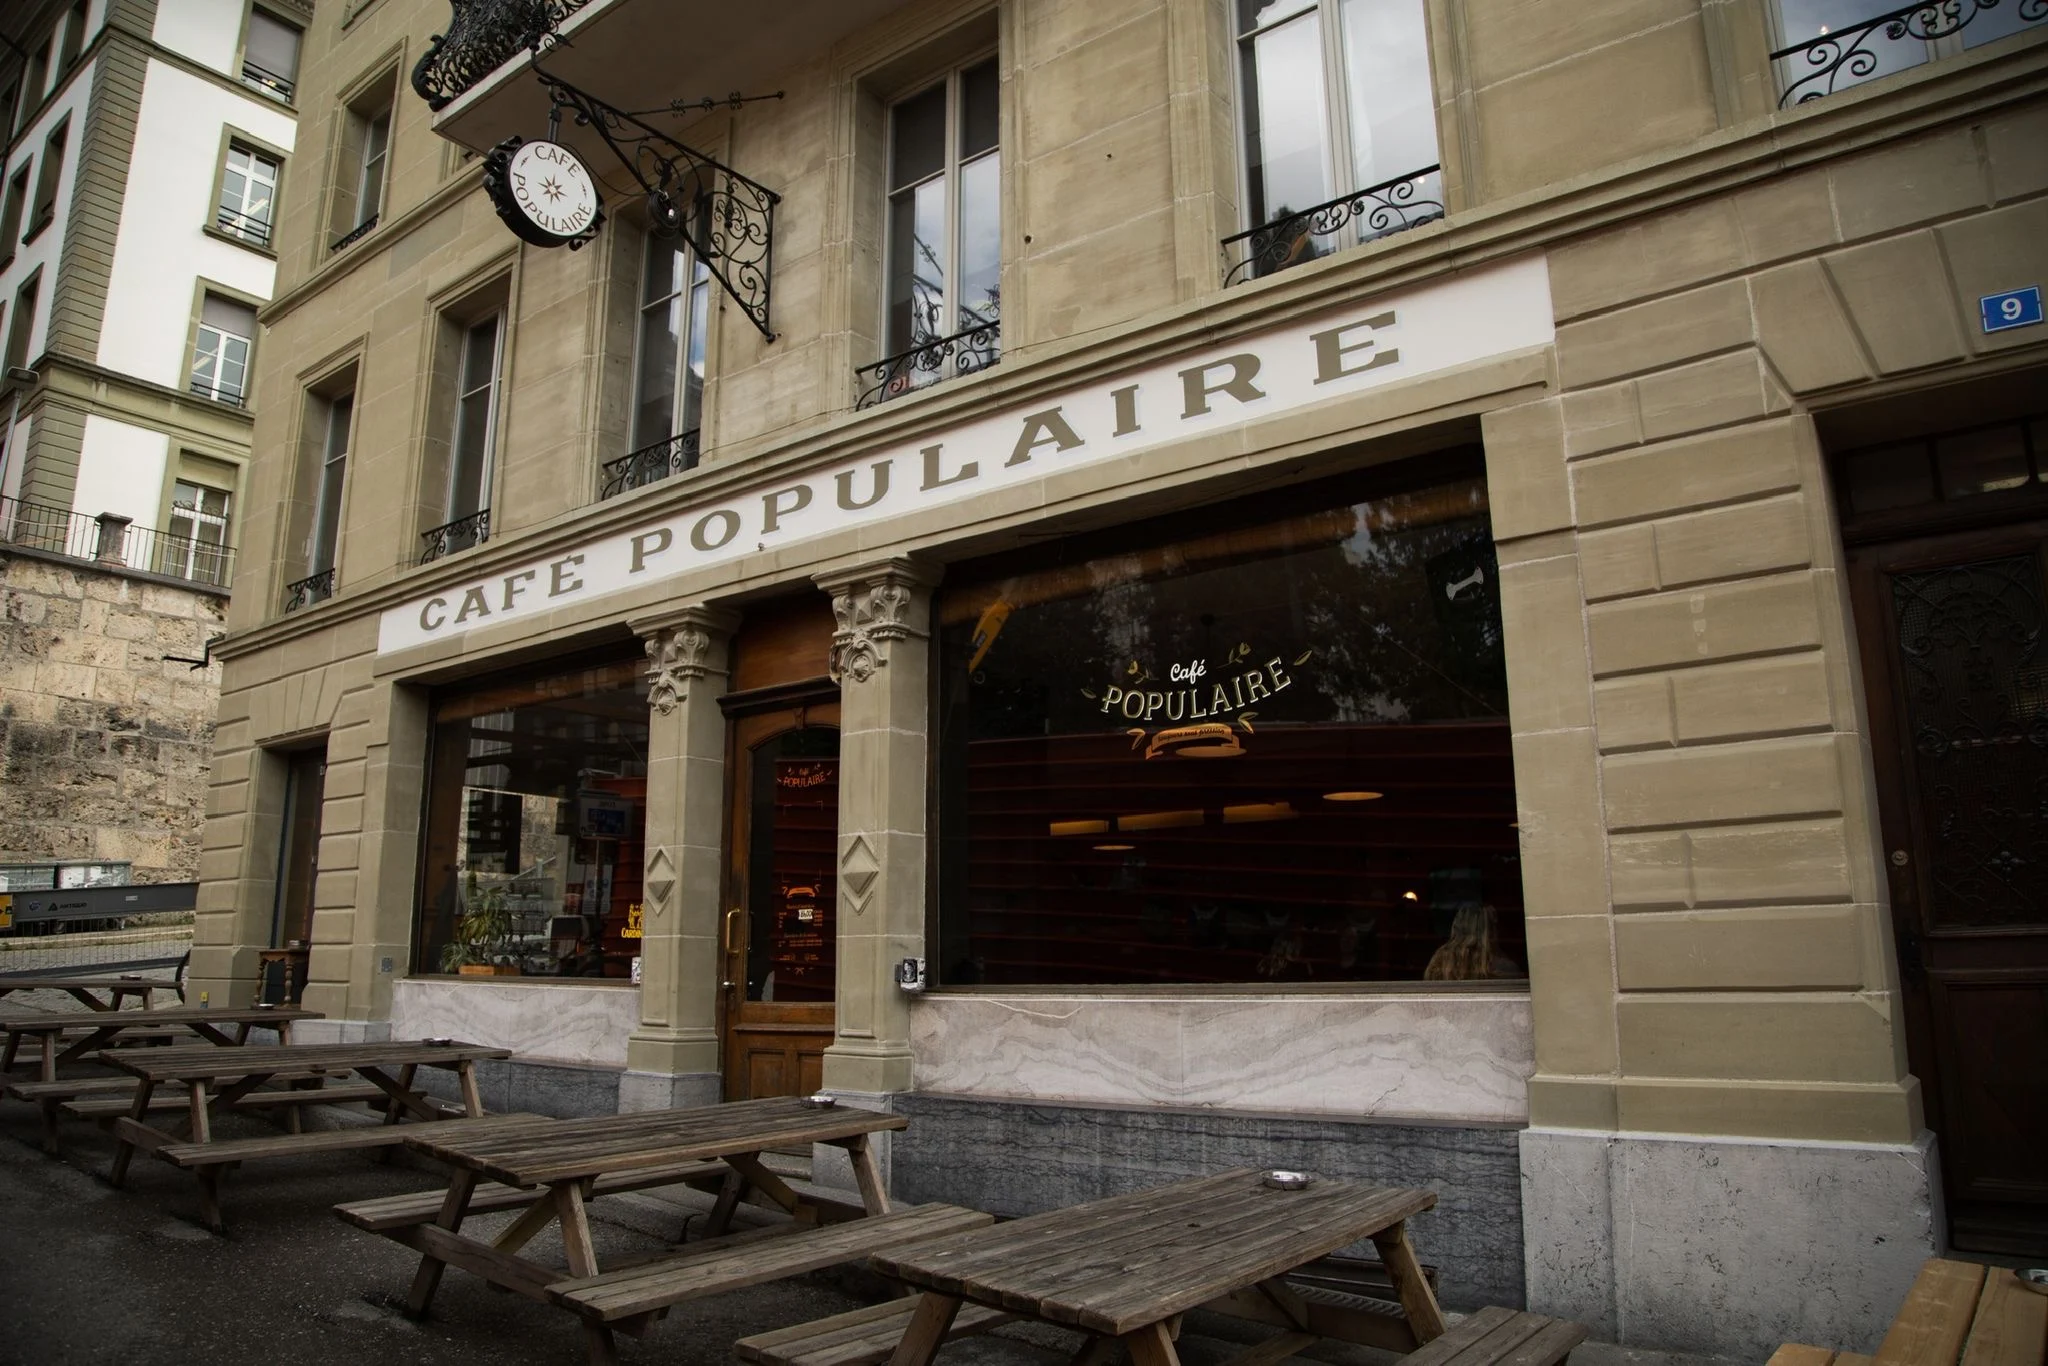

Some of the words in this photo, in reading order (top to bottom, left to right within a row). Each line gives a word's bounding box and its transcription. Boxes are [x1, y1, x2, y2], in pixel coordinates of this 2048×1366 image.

[534, 145, 581, 178] CAFE
[513, 172, 592, 233] POPULAIRE
[2001, 298, 2022, 321] 9
[419, 554, 585, 632] CAFÉ
[628, 310, 1400, 575] POPULAIRE
[1170, 659, 1206, 684] Café
[1101, 657, 1291, 721] POPULAIRE
[783, 772, 826, 788] POPULAIRE
